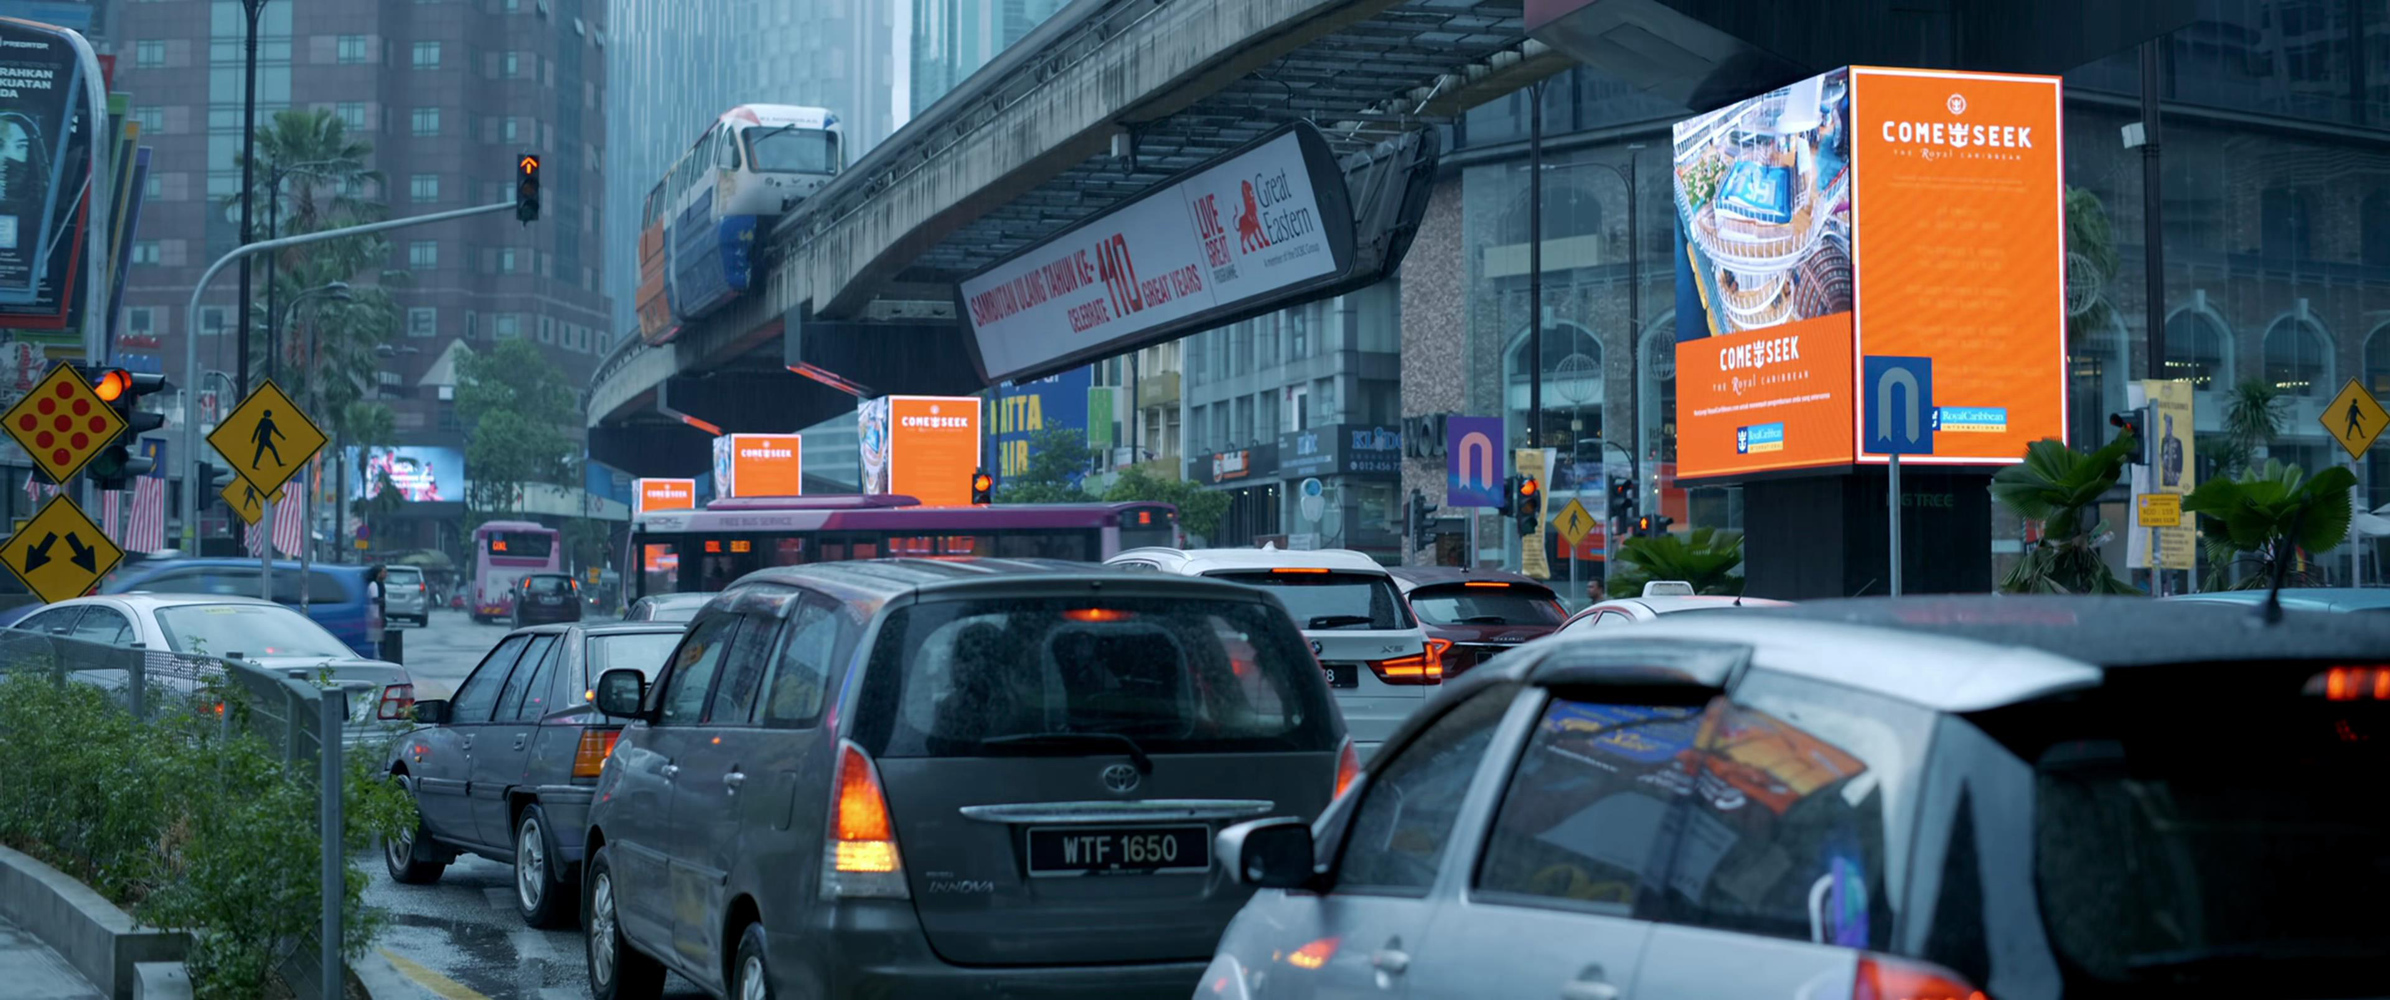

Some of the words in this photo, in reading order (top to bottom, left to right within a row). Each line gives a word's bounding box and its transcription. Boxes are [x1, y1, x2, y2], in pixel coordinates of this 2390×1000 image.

[1882, 120, 1944, 144] COME
[1973, 125, 2032, 148] SEEK
[1920, 147, 1953, 161] Royal
[1960, 152, 2022, 161] CARIBBEAN
[1255, 167, 1292, 208] Great
[1193, 193, 1224, 240] LIVE
[1263, 207, 1314, 245] Eastern
[1205, 235, 1232, 268] GREAT
[971, 280, 1020, 327] SAMBUTAN
[1013, 268, 1048, 311] ULANG
[1042, 254, 1078, 300] TAHUN
[1096, 232, 1143, 319] 110
[1067, 298, 1111, 333] CELEBRATE
[1141, 274, 1170, 308] GREAT
[1169, 264, 1202, 298] YEARS
[1720, 344, 1752, 371] COME
[1766, 335, 1799, 364] SEEK
[1732, 374, 1756, 396] Royal
[1761, 369, 1809, 385] CARIBBEAN
[902, 416, 929, 427] COME
[941, 417, 968, 427] SEEK
[1942, 411, 2004, 423] RoyalCaribbean
[741, 448, 762, 458] COME
[771, 449, 792, 458] SEEK
[999, 440, 1029, 476] AIR
[719, 517, 739, 526] FREE
[742, 517, 759, 526] BUS
[760, 517, 792, 526] SERVICE
[1064, 836, 1111, 863] WTF
[1120, 835, 1177, 862] 1650
[928, 880, 994, 893] INNOVA
